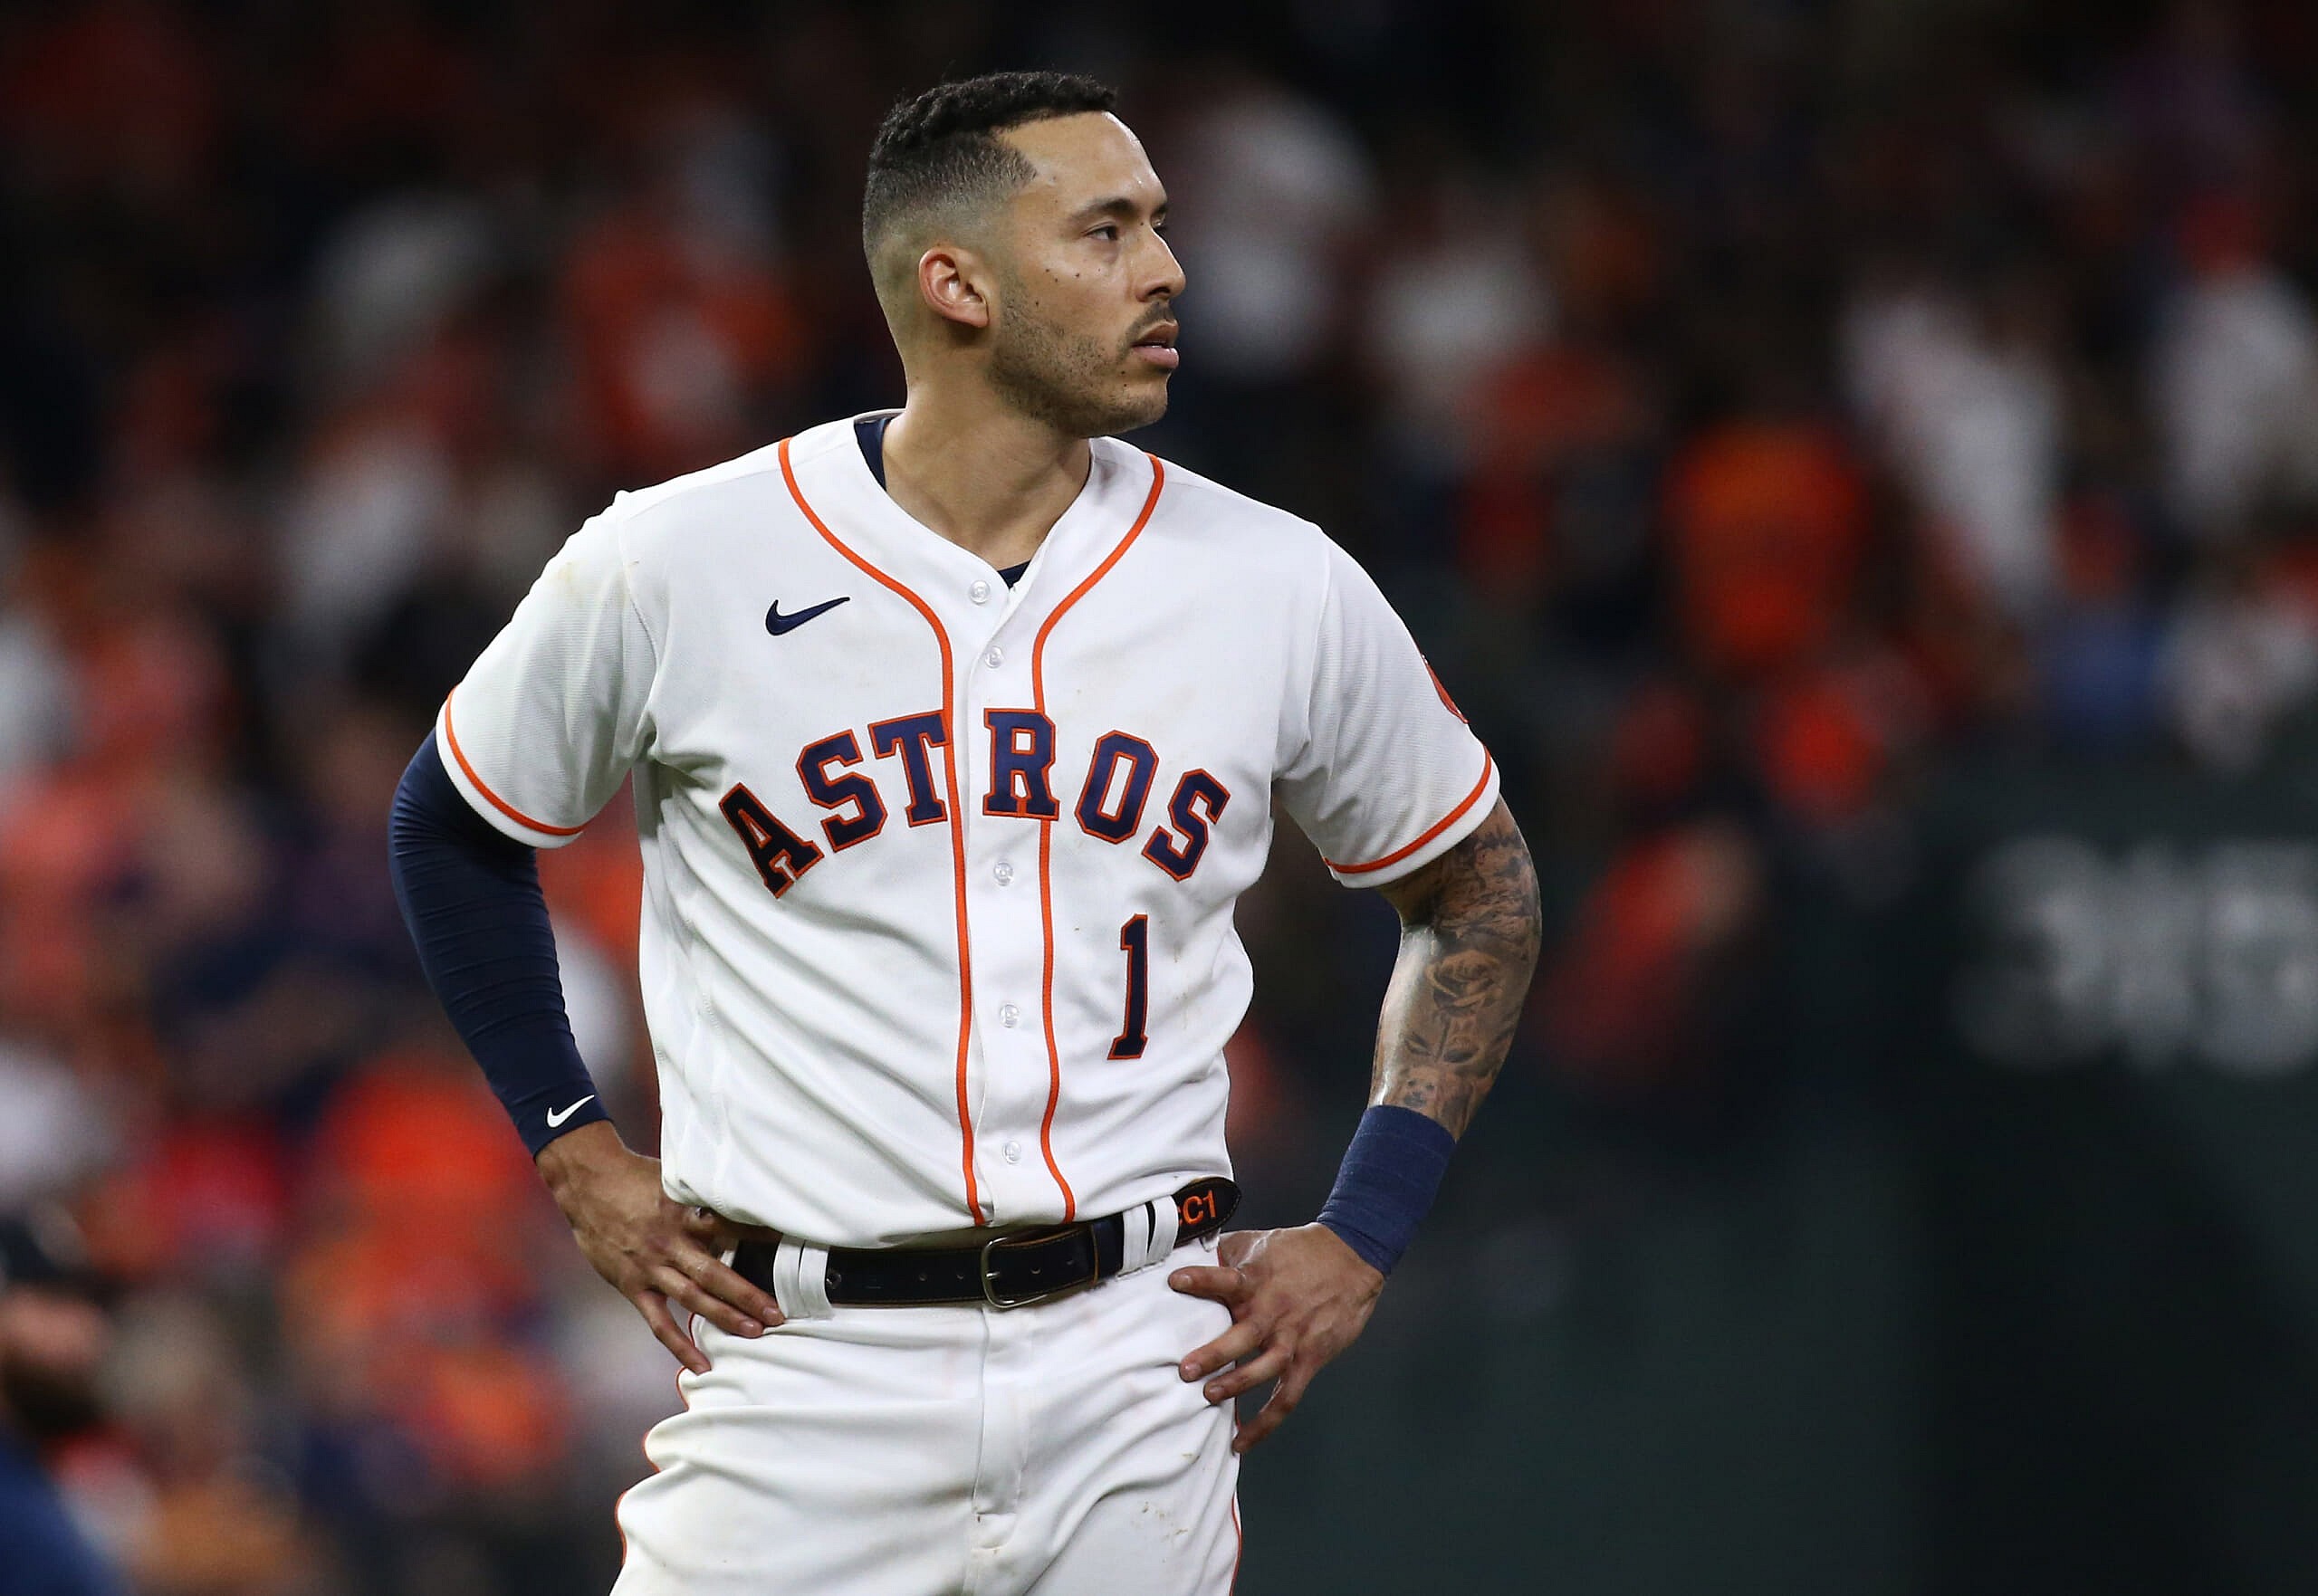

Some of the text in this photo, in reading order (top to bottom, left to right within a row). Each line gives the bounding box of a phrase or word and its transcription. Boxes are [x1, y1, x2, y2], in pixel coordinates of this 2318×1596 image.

[718, 708, 1231, 899] ASTROS
[1107, 913, 1147, 1059] 1
[1177, 1190, 1217, 1226] C1
